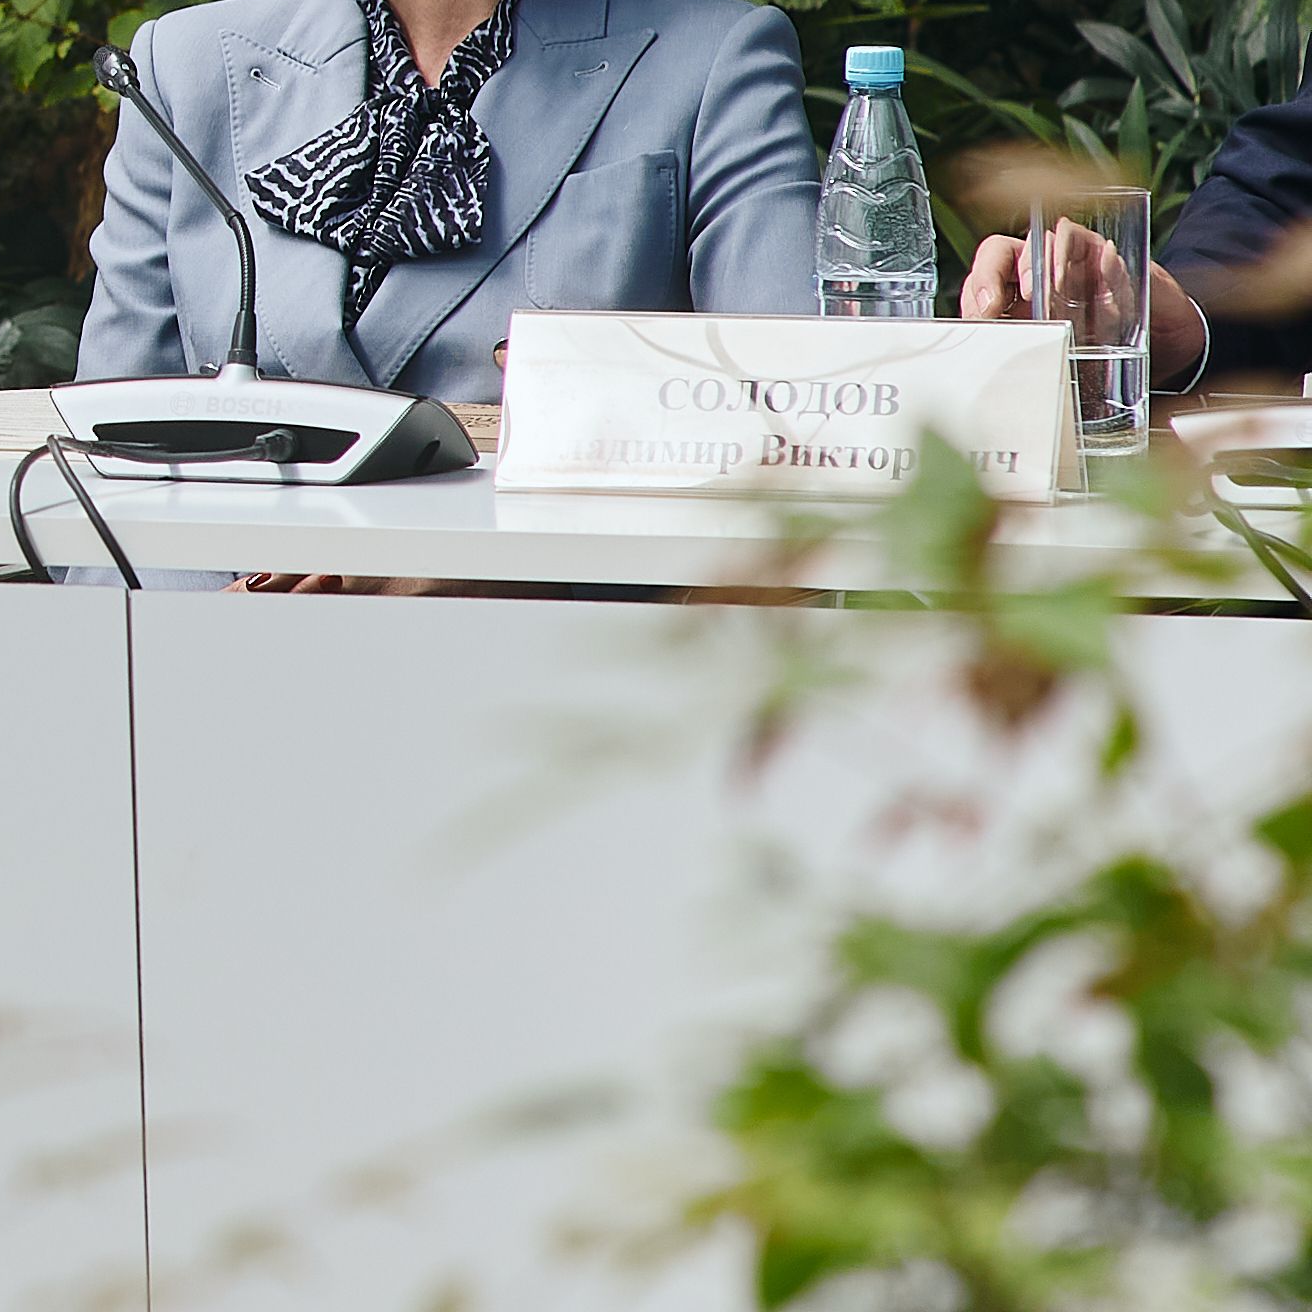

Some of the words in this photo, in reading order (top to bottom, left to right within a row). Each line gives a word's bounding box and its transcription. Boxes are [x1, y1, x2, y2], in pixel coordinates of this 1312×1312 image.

[205, 395, 283, 417] BOSCH
[657, 376, 901, 420] СОЛОДОВ
[559, 437, 744, 476] ладимир
[757, 432, 1021, 481] Викторич
